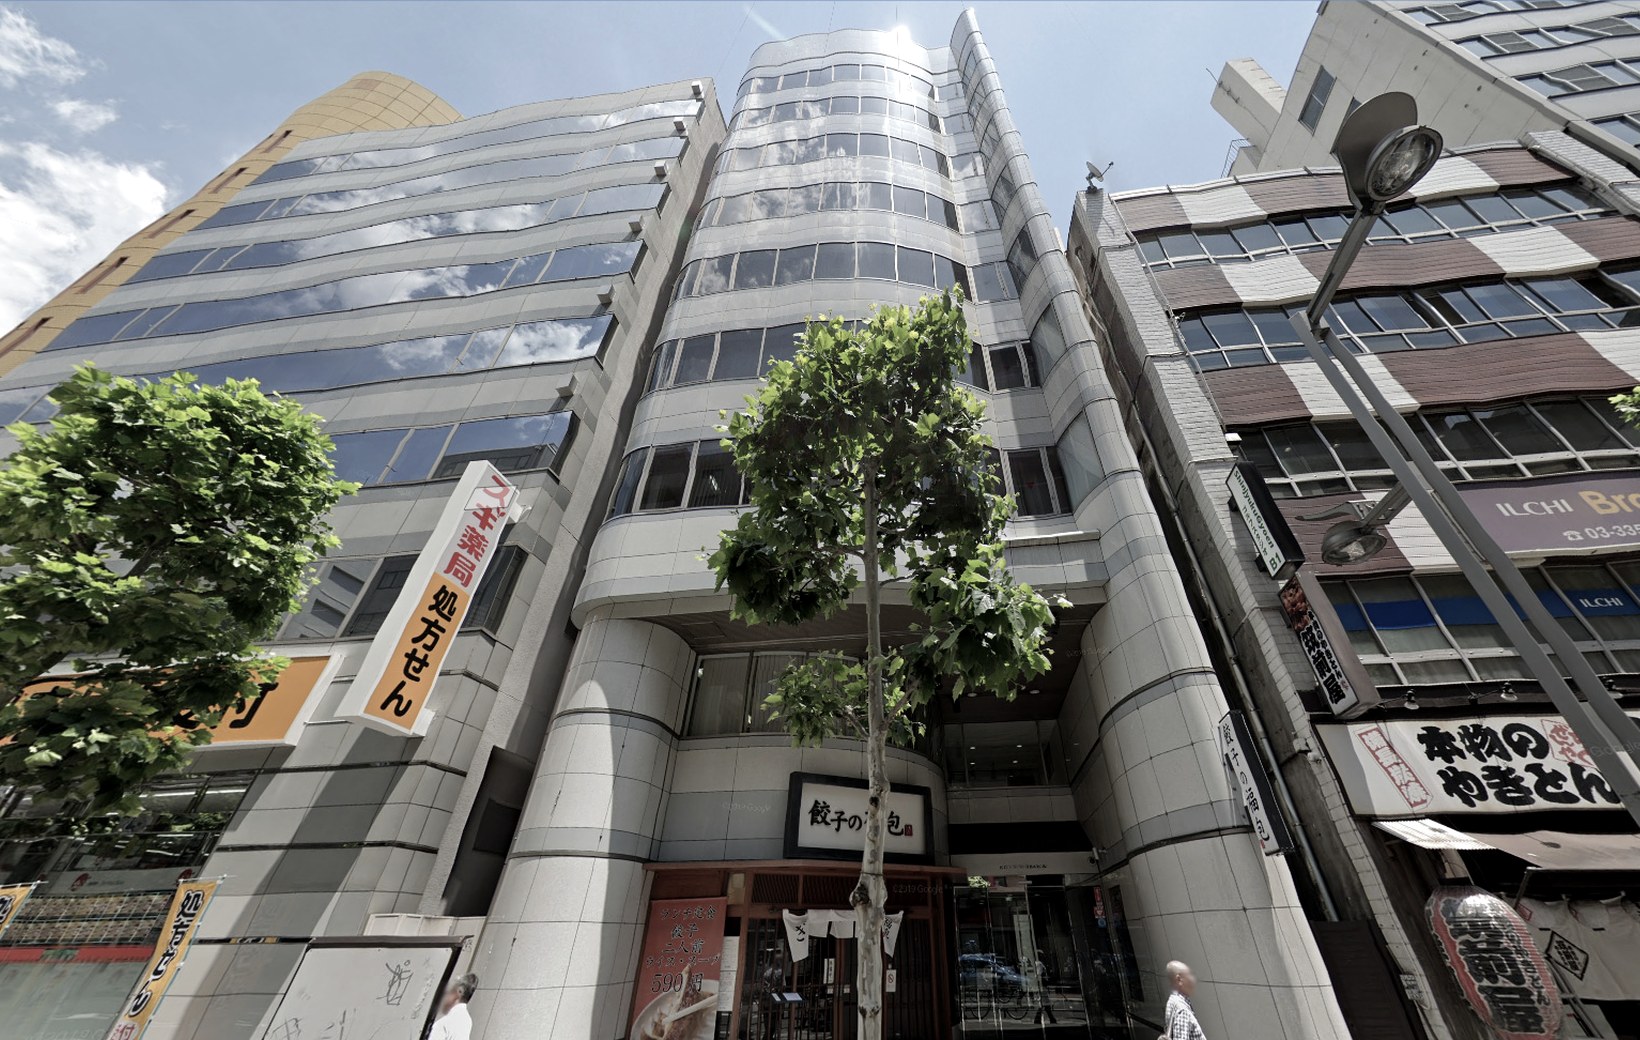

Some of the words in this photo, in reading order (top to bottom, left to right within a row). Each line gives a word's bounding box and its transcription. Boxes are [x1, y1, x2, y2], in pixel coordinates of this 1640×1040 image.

[1495, 499, 1574, 517] ILCHI
[444, 474, 511, 588] スギ薬局
[1268, 552, 1282, 572] B1
[1579, 597, 1623, 608] ILCHI
[379, 584, 459, 718] 処方せん
[1416, 722, 1550, 764] 本物の
[1436, 762, 1622, 808] やきとん
[808, 799, 905, 836] 餃子の包
[661, 905, 716, 920] ランチ定食
[671, 922, 698, 939] 餃子
[127, 889, 205, 1018] 処方せん
[661, 938, 705, 954] 二人前
